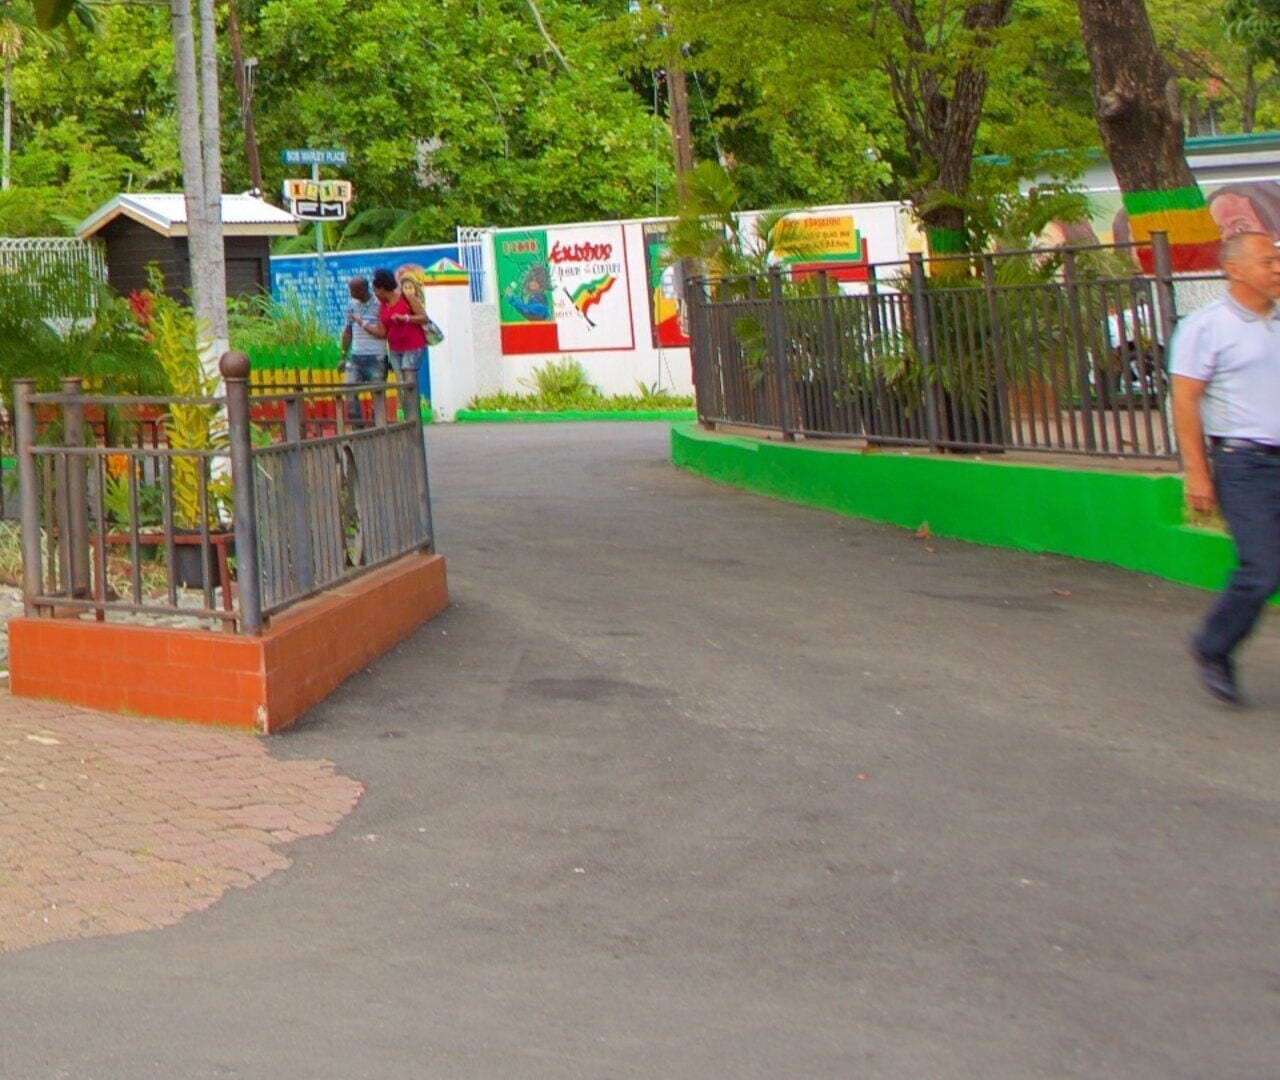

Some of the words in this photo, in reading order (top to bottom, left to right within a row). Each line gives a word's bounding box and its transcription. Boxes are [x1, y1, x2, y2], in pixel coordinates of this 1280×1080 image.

[286, 150, 300, 162] BOB
[301, 150, 324, 162] MARLEY
[326, 150, 346, 162] PLACE
[297, 201, 342, 217] FM
